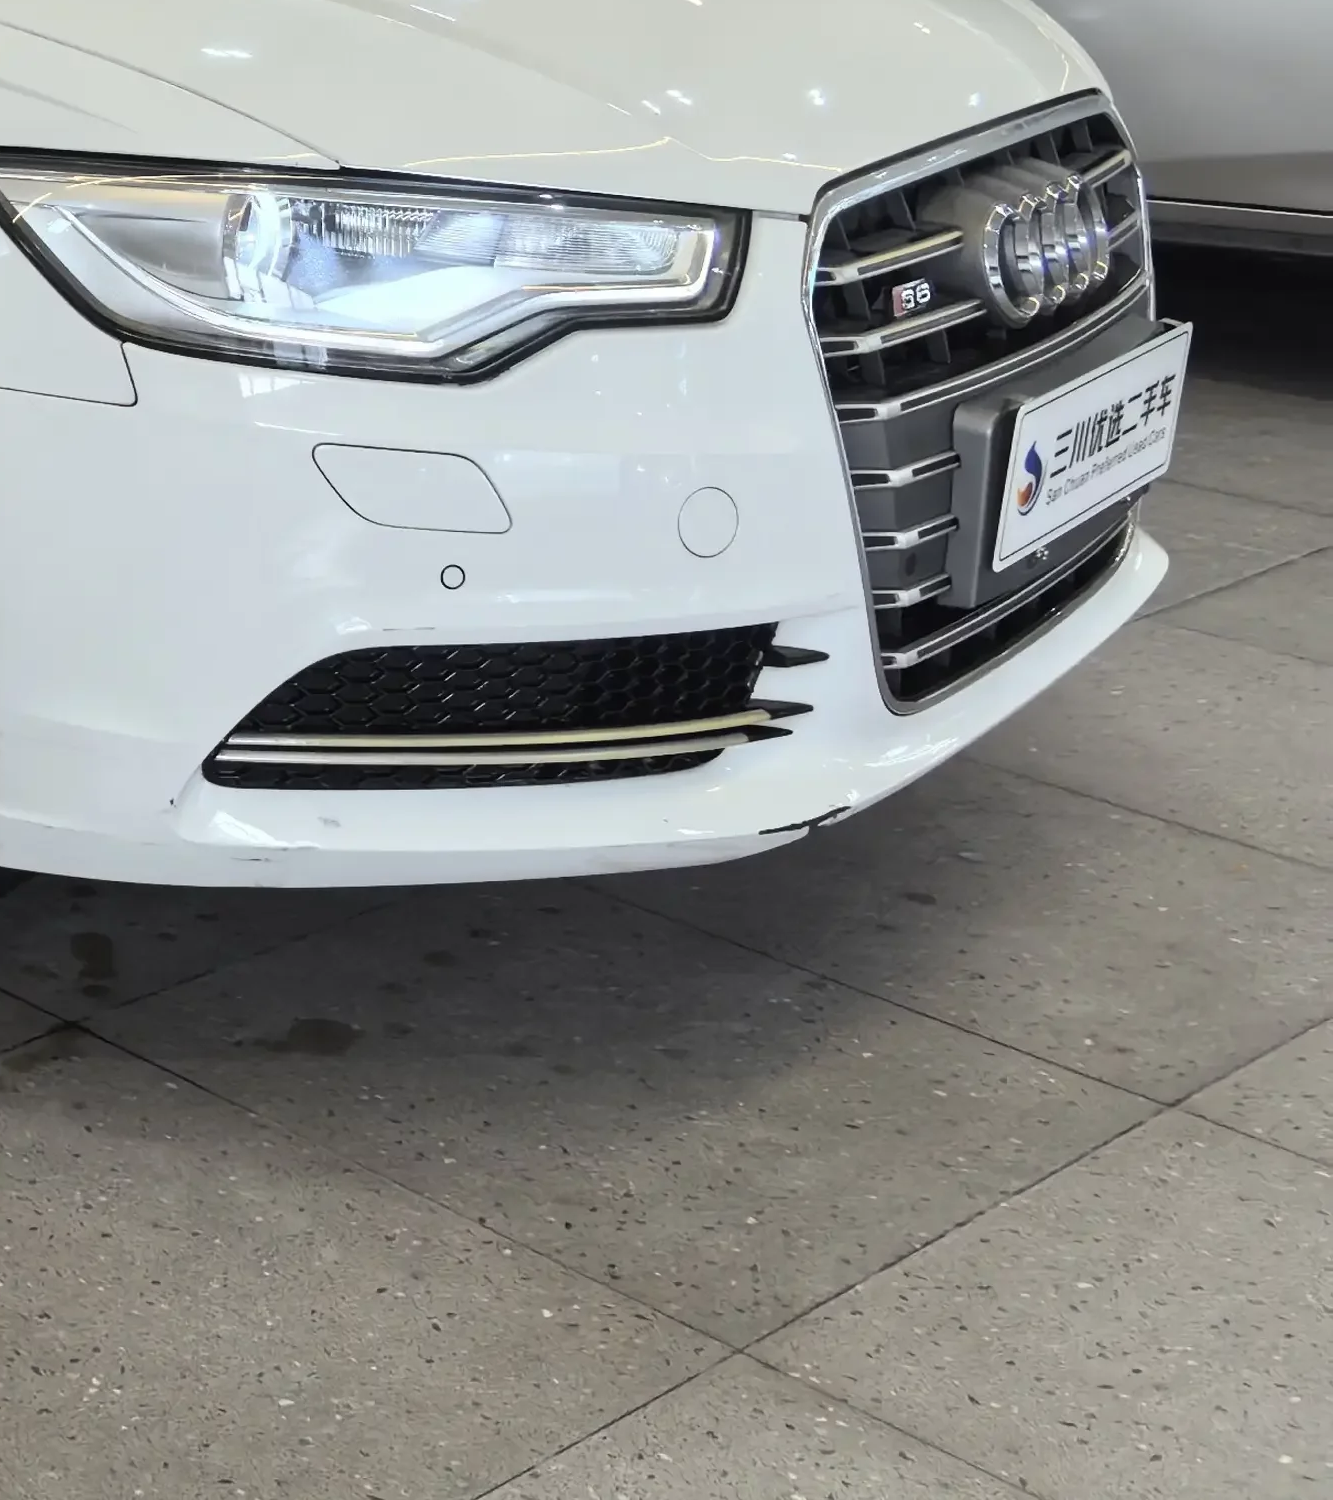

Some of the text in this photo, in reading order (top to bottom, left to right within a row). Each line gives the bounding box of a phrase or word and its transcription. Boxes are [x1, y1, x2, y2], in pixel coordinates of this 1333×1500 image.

[1050, 374, 1176, 478] 三川优选二手车
